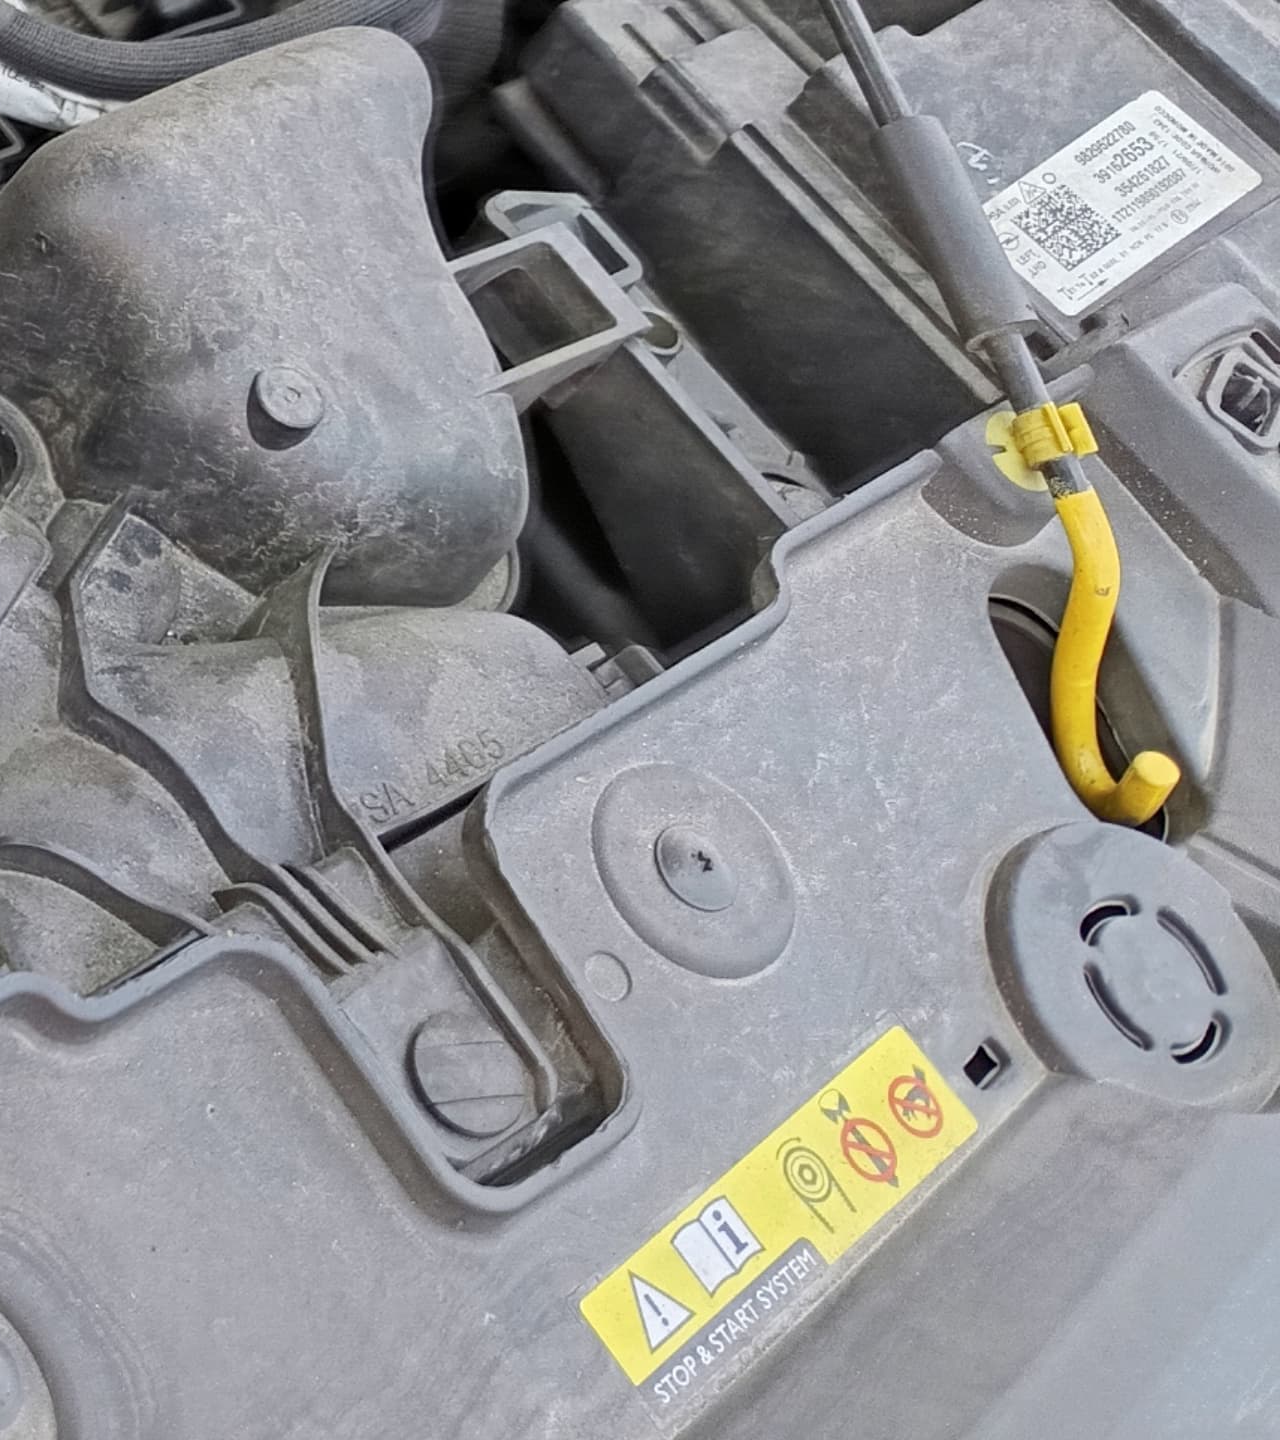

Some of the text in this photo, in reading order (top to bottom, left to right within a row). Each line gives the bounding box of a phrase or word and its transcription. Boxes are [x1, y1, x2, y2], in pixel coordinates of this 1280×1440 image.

[1073, 118, 1136, 166] 9829522780
[1092, 134, 1154, 184] 39162653
[654, 1248, 817, 1403] STOP & START SYSTEM
